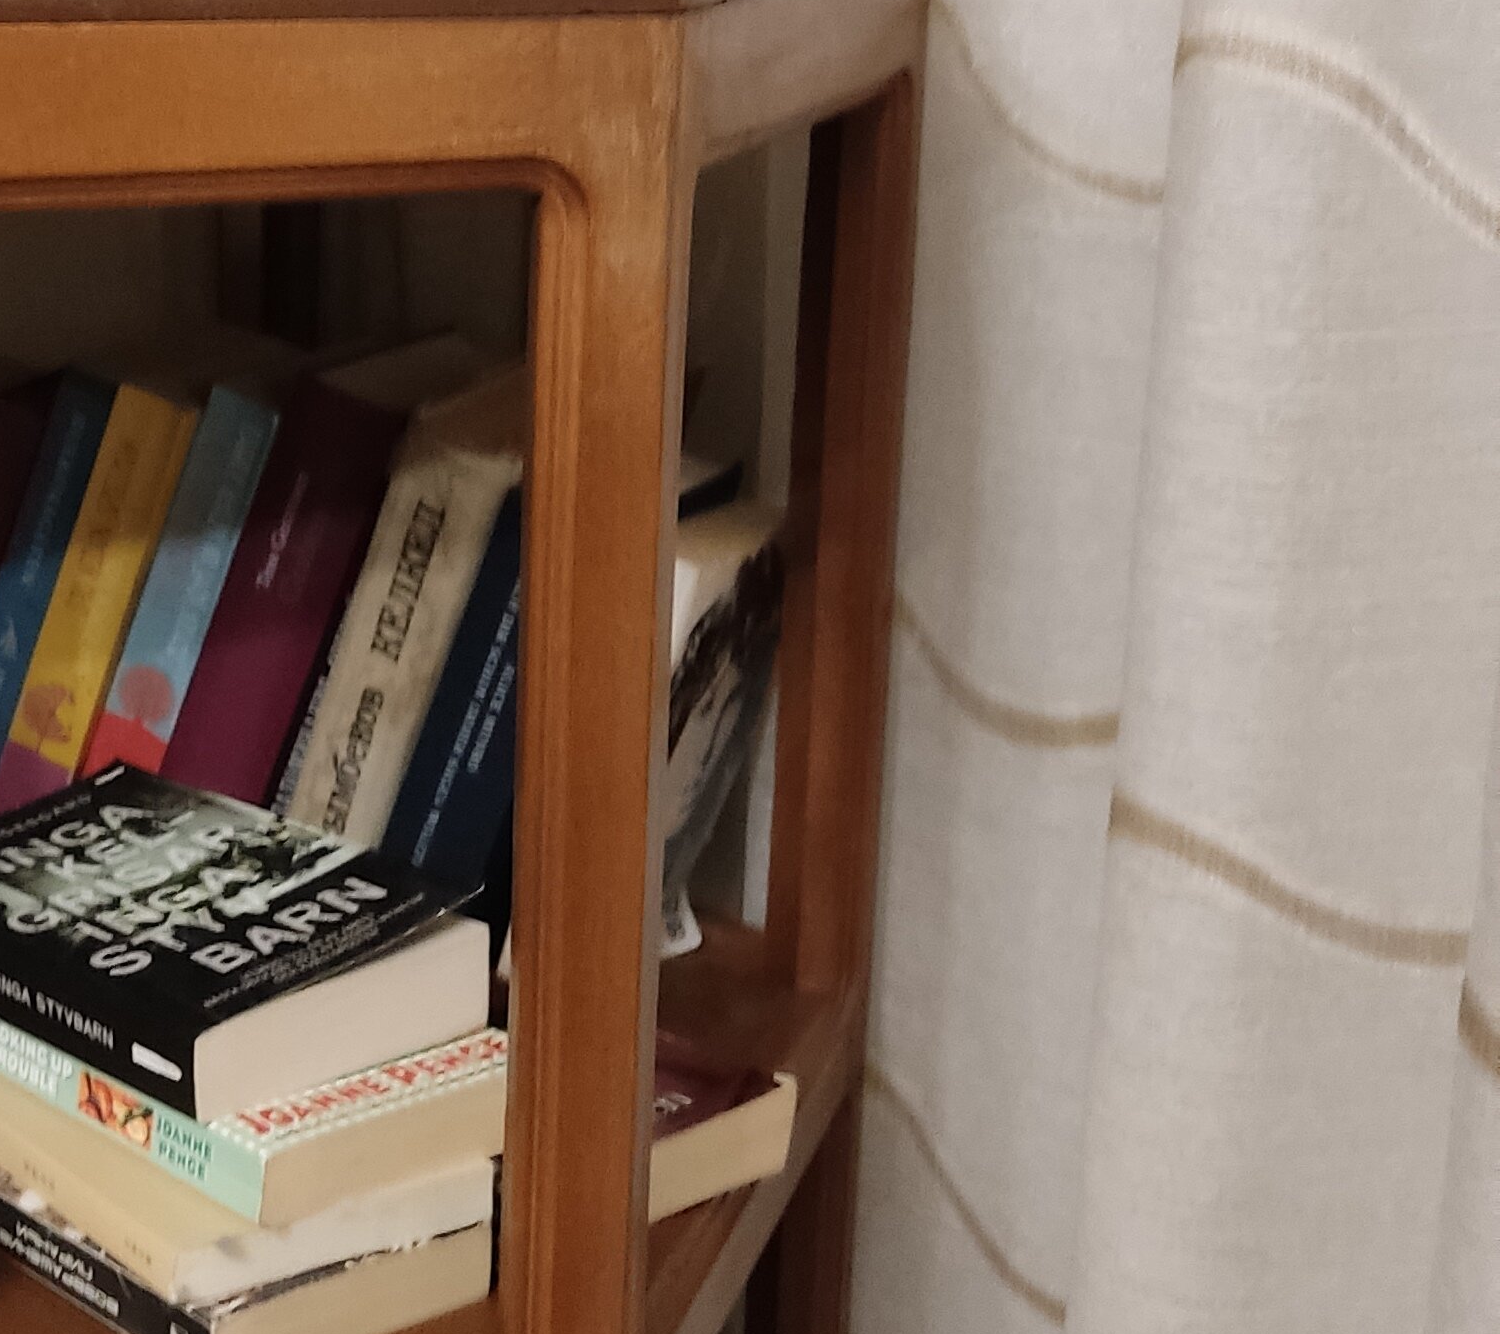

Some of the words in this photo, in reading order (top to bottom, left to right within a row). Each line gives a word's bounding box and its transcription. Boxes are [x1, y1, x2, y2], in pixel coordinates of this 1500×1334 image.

[191, 876, 388, 974] BARN
[35, 983, 115, 1049] STYVBARN
[237, 1077, 391, 1135] JOANNE
